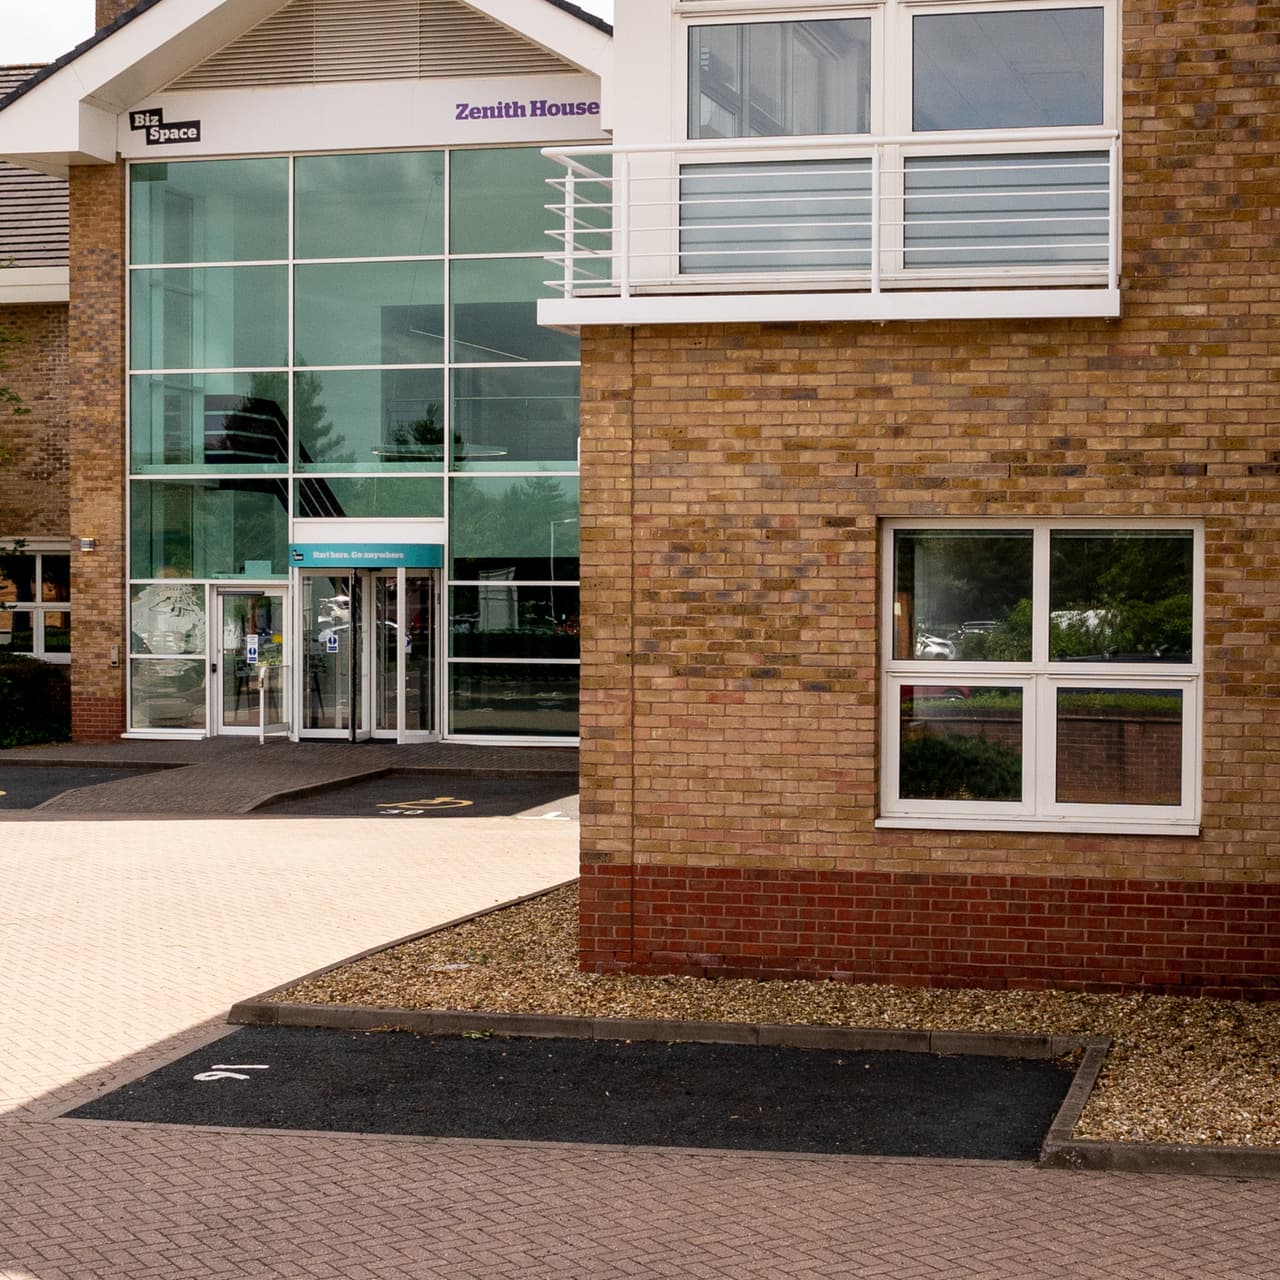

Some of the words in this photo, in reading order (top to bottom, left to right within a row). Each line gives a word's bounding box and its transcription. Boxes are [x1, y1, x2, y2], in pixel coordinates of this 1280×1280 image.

[455, 101, 526, 120] Zenith
[529, 100, 600, 117] House
[134, 113, 159, 126] Biz
[149, 127, 197, 142] Space
[351, 551, 363, 559] Go
